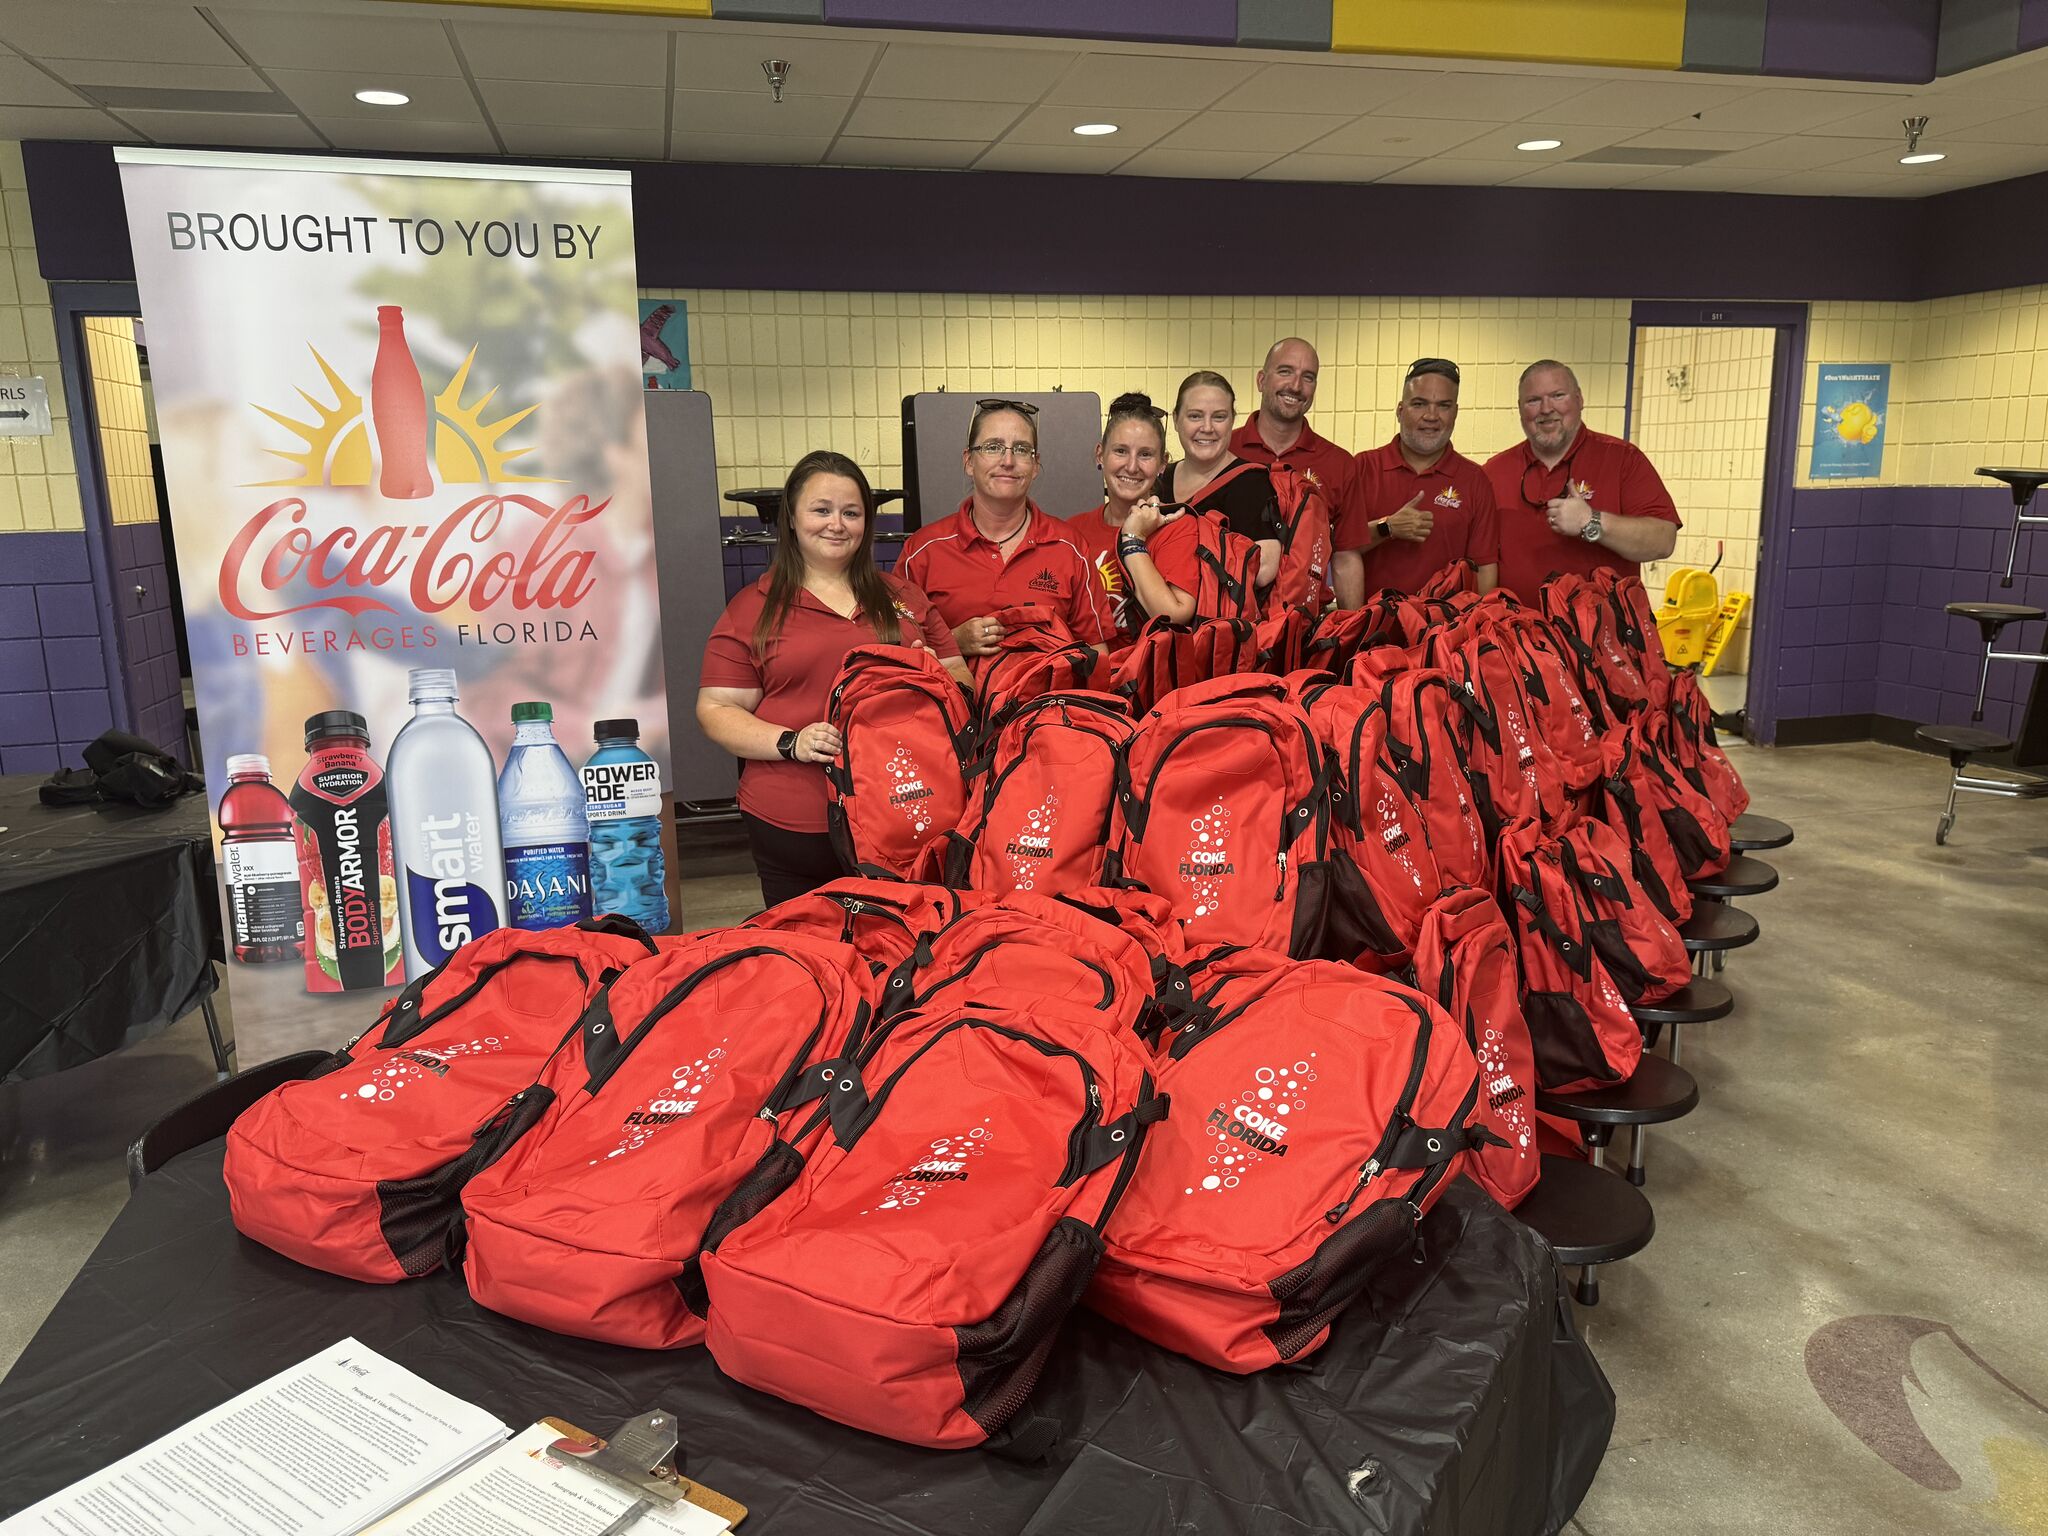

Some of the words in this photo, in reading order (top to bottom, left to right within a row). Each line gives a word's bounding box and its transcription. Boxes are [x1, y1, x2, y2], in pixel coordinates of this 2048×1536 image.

[167, 211, 377, 254] BROUGHT
[389, 217, 445, 256] TO
[454, 219, 539, 259] YOU
[553, 223, 602, 260] BY
[219, 493, 614, 622] Coca-Cola
[232, 625, 438, 657] BEVERAGES
[457, 620, 599, 646] FLORIDA
[316, 752, 363, 765] Strawberry
[325, 760, 356, 769] Banana
[318, 773, 363, 783] SUPERIOR
[319, 779, 363, 788] HYDRATION
[584, 763, 655, 785] POWER
[585, 783, 626, 802] ADE
[889, 787, 934, 805] FLORIDA
[896, 780, 923, 794] COKE
[608, 809, 627, 817] DRINK
[1019, 835, 1051, 848] COKE
[1384, 822, 1402, 842] COKE
[464, 812, 484, 874] water
[523, 848, 547, 856] PURIFIED
[1005, 843, 1054, 858] FLORIDA
[1191, 851, 1226, 864] COKE
[1179, 863, 1235, 876] FLORIDA
[334, 876, 342, 905] Banana
[420, 812, 473, 951] smart
[507, 871, 587, 904] DASANI
[339, 905, 347, 950] Strawberry
[1488, 1074, 1515, 1096] COKE
[649, 1100, 698, 1113] COKE
[1488, 1084, 1526, 1111] FLORIDA
[1233, 1104, 1288, 1141] COKE
[1206, 1108, 1289, 1158] FLORIDA
